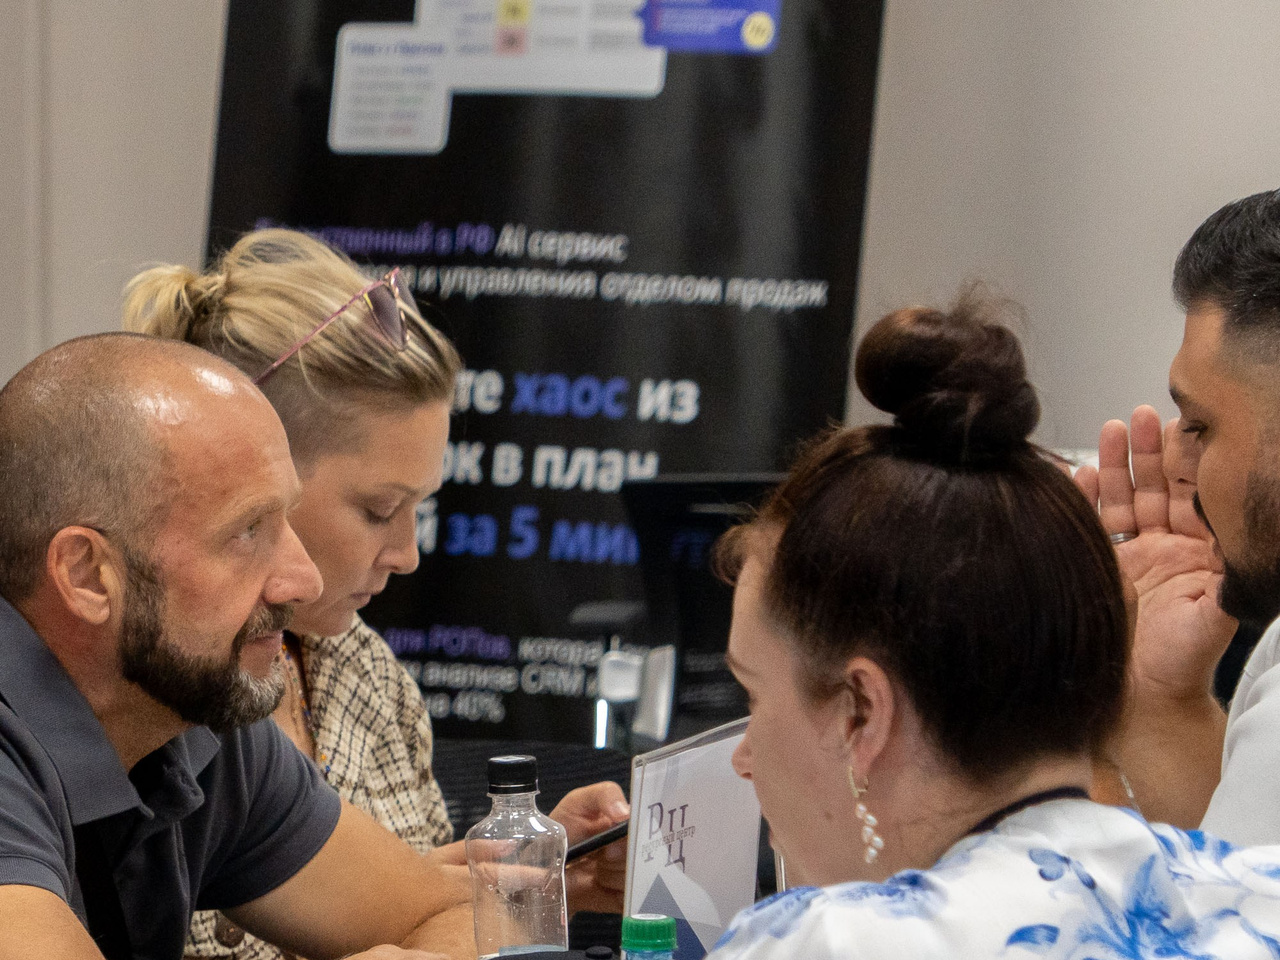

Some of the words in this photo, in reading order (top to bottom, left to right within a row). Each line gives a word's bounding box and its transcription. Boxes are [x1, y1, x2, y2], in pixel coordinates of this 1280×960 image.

[455, 221, 495, 257] РФ
[527, 229, 629, 267] сервис
[438, 264, 597, 300] управления
[599, 270, 722, 307] отделом
[723, 276, 829, 314] продаж
[511, 372, 628, 419] хаос
[637, 377, 700, 425] из
[490, 442, 524, 488] в
[444, 512, 499, 558] за
[506, 504, 540, 560] 5
[520, 661, 585, 697] CRM
[451, 690, 506, 724] 40%
